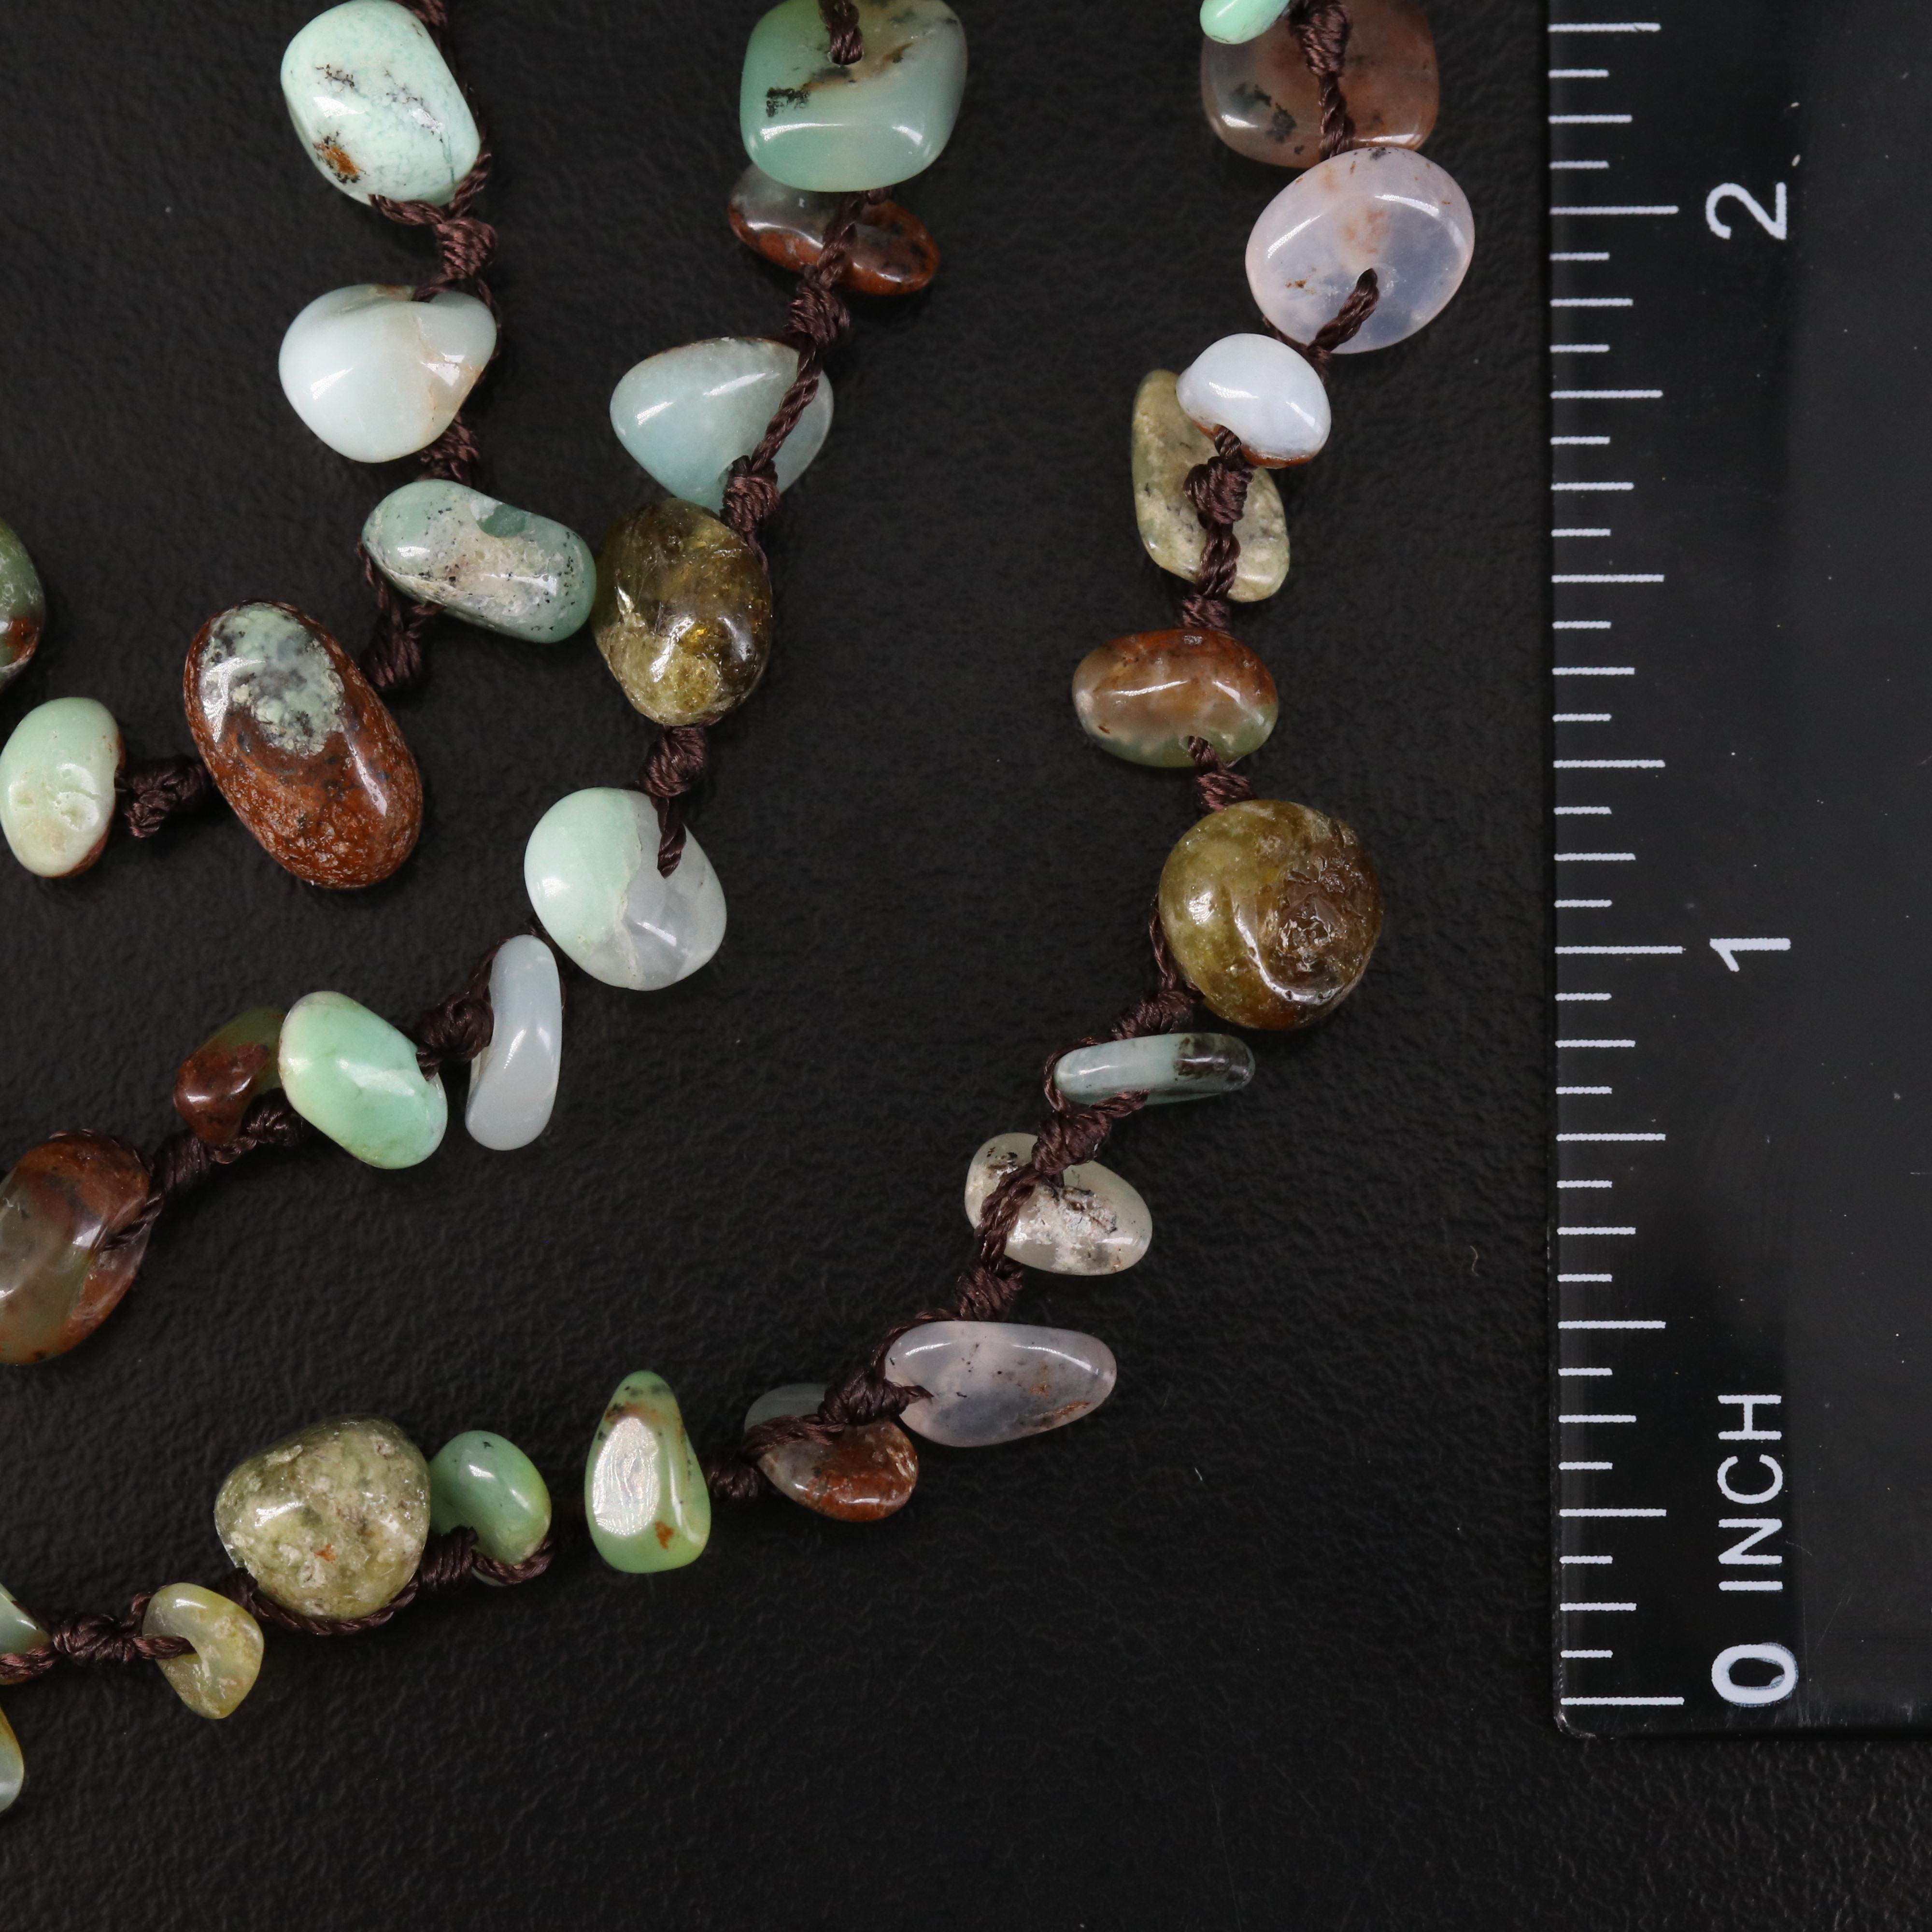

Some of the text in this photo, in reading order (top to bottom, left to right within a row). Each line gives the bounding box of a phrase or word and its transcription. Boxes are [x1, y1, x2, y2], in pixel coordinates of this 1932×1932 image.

[1705, 182, 1787, 240] 2
[1709, 938, 1791, 972] 1
[1711, 1394, 1799, 1706] 0 INCH
